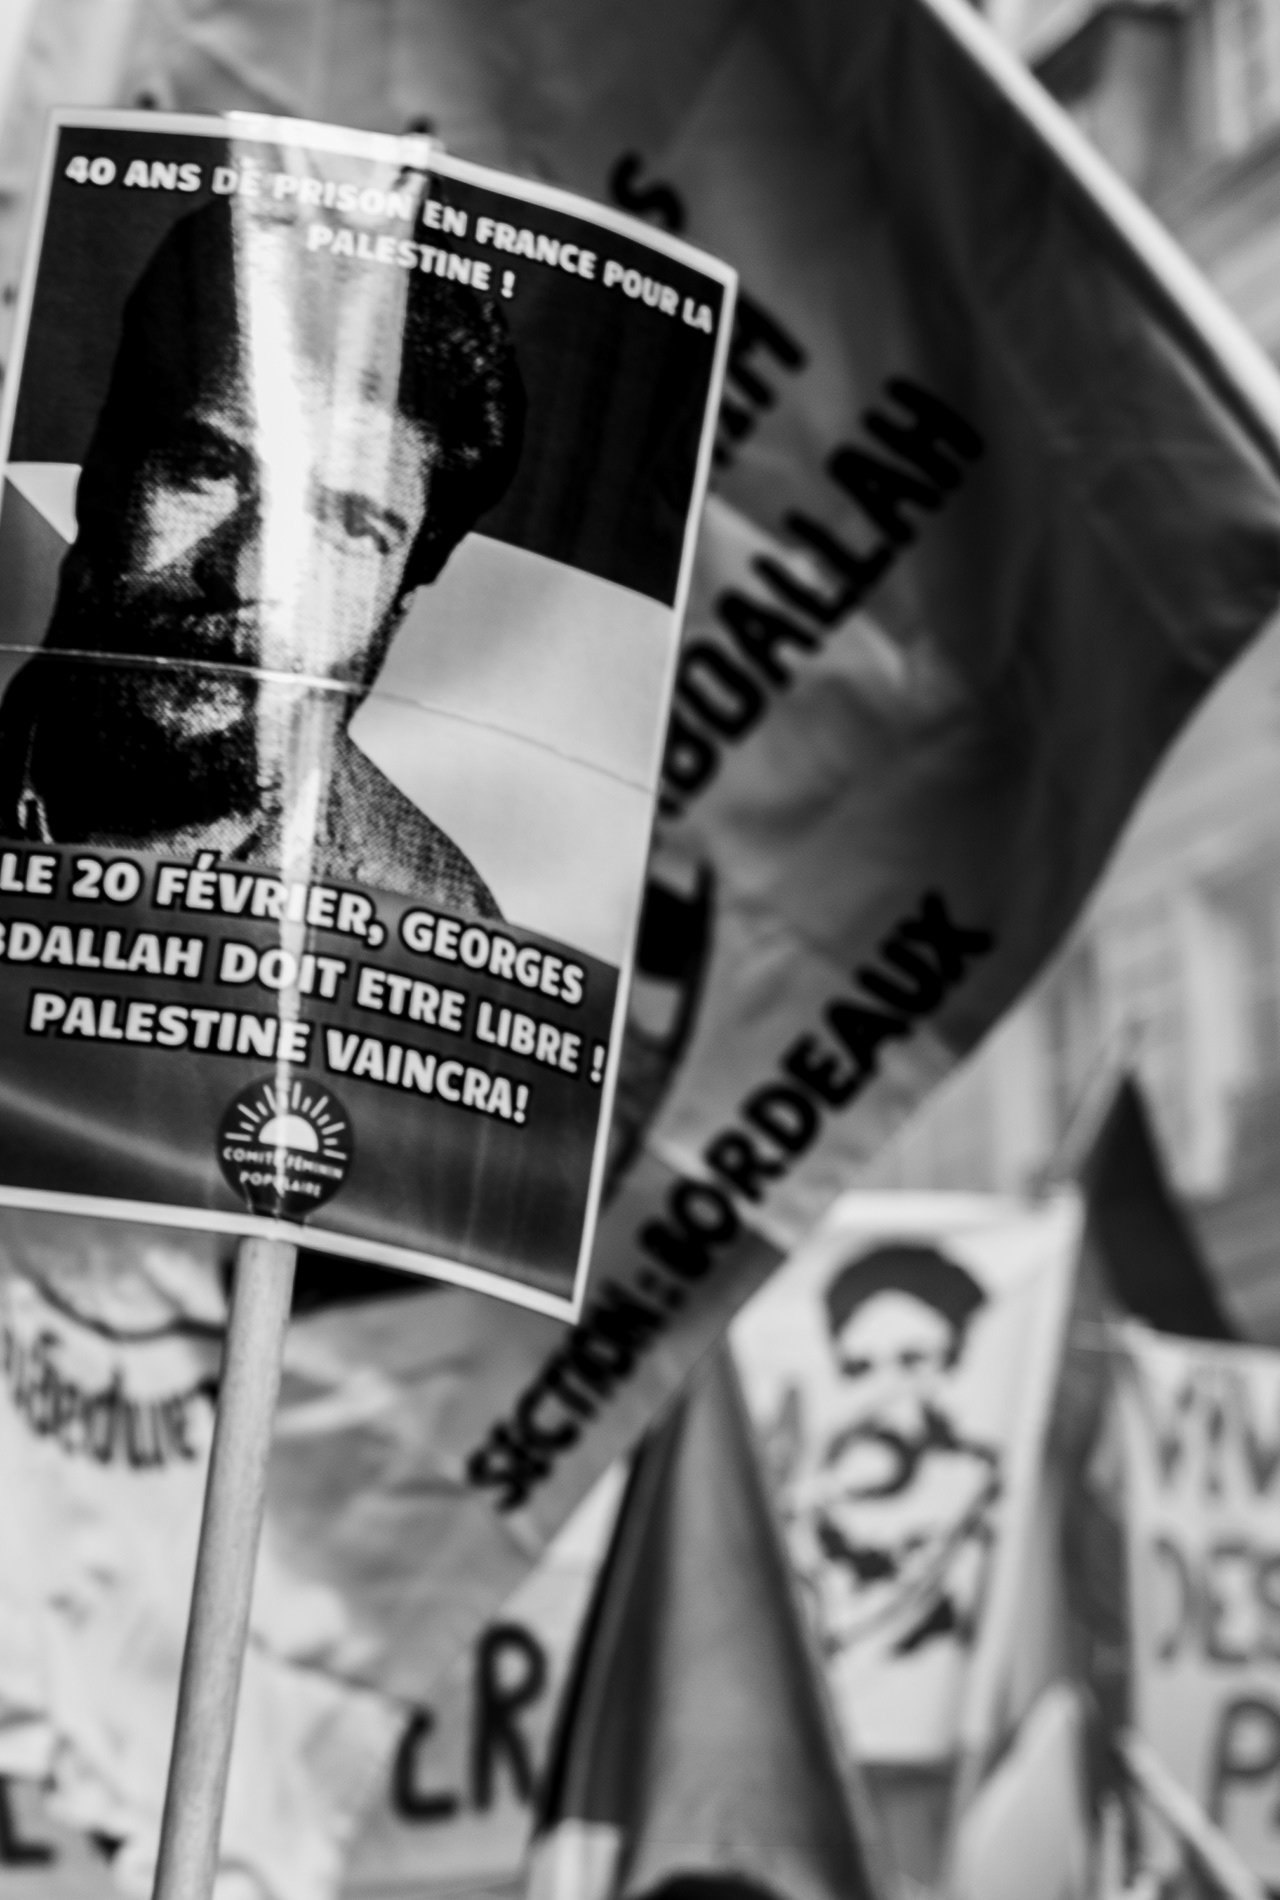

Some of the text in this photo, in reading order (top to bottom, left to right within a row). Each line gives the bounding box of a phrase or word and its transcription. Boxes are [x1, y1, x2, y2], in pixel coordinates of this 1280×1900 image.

[65, 155, 713, 335] 40 ANS DE PRISON EN FRANCE POUR LA
[306, 224, 516, 299] PALESTINE !
[72, 858, 139, 902] 20
[156, 852, 386, 946] FÉVRIER,
[401, 911, 584, 1005] GEORGES
[29, 992, 529, 1123] PALESTINE VAINCRA!
[220, 945, 345, 999] DOIT
[357, 966, 465, 1032] ETRE
[475, 1001, 579, 1074] LIBRE
[590, 1043, 606, 1083] !
[638, 888, 996, 1282] BORDEAUX
